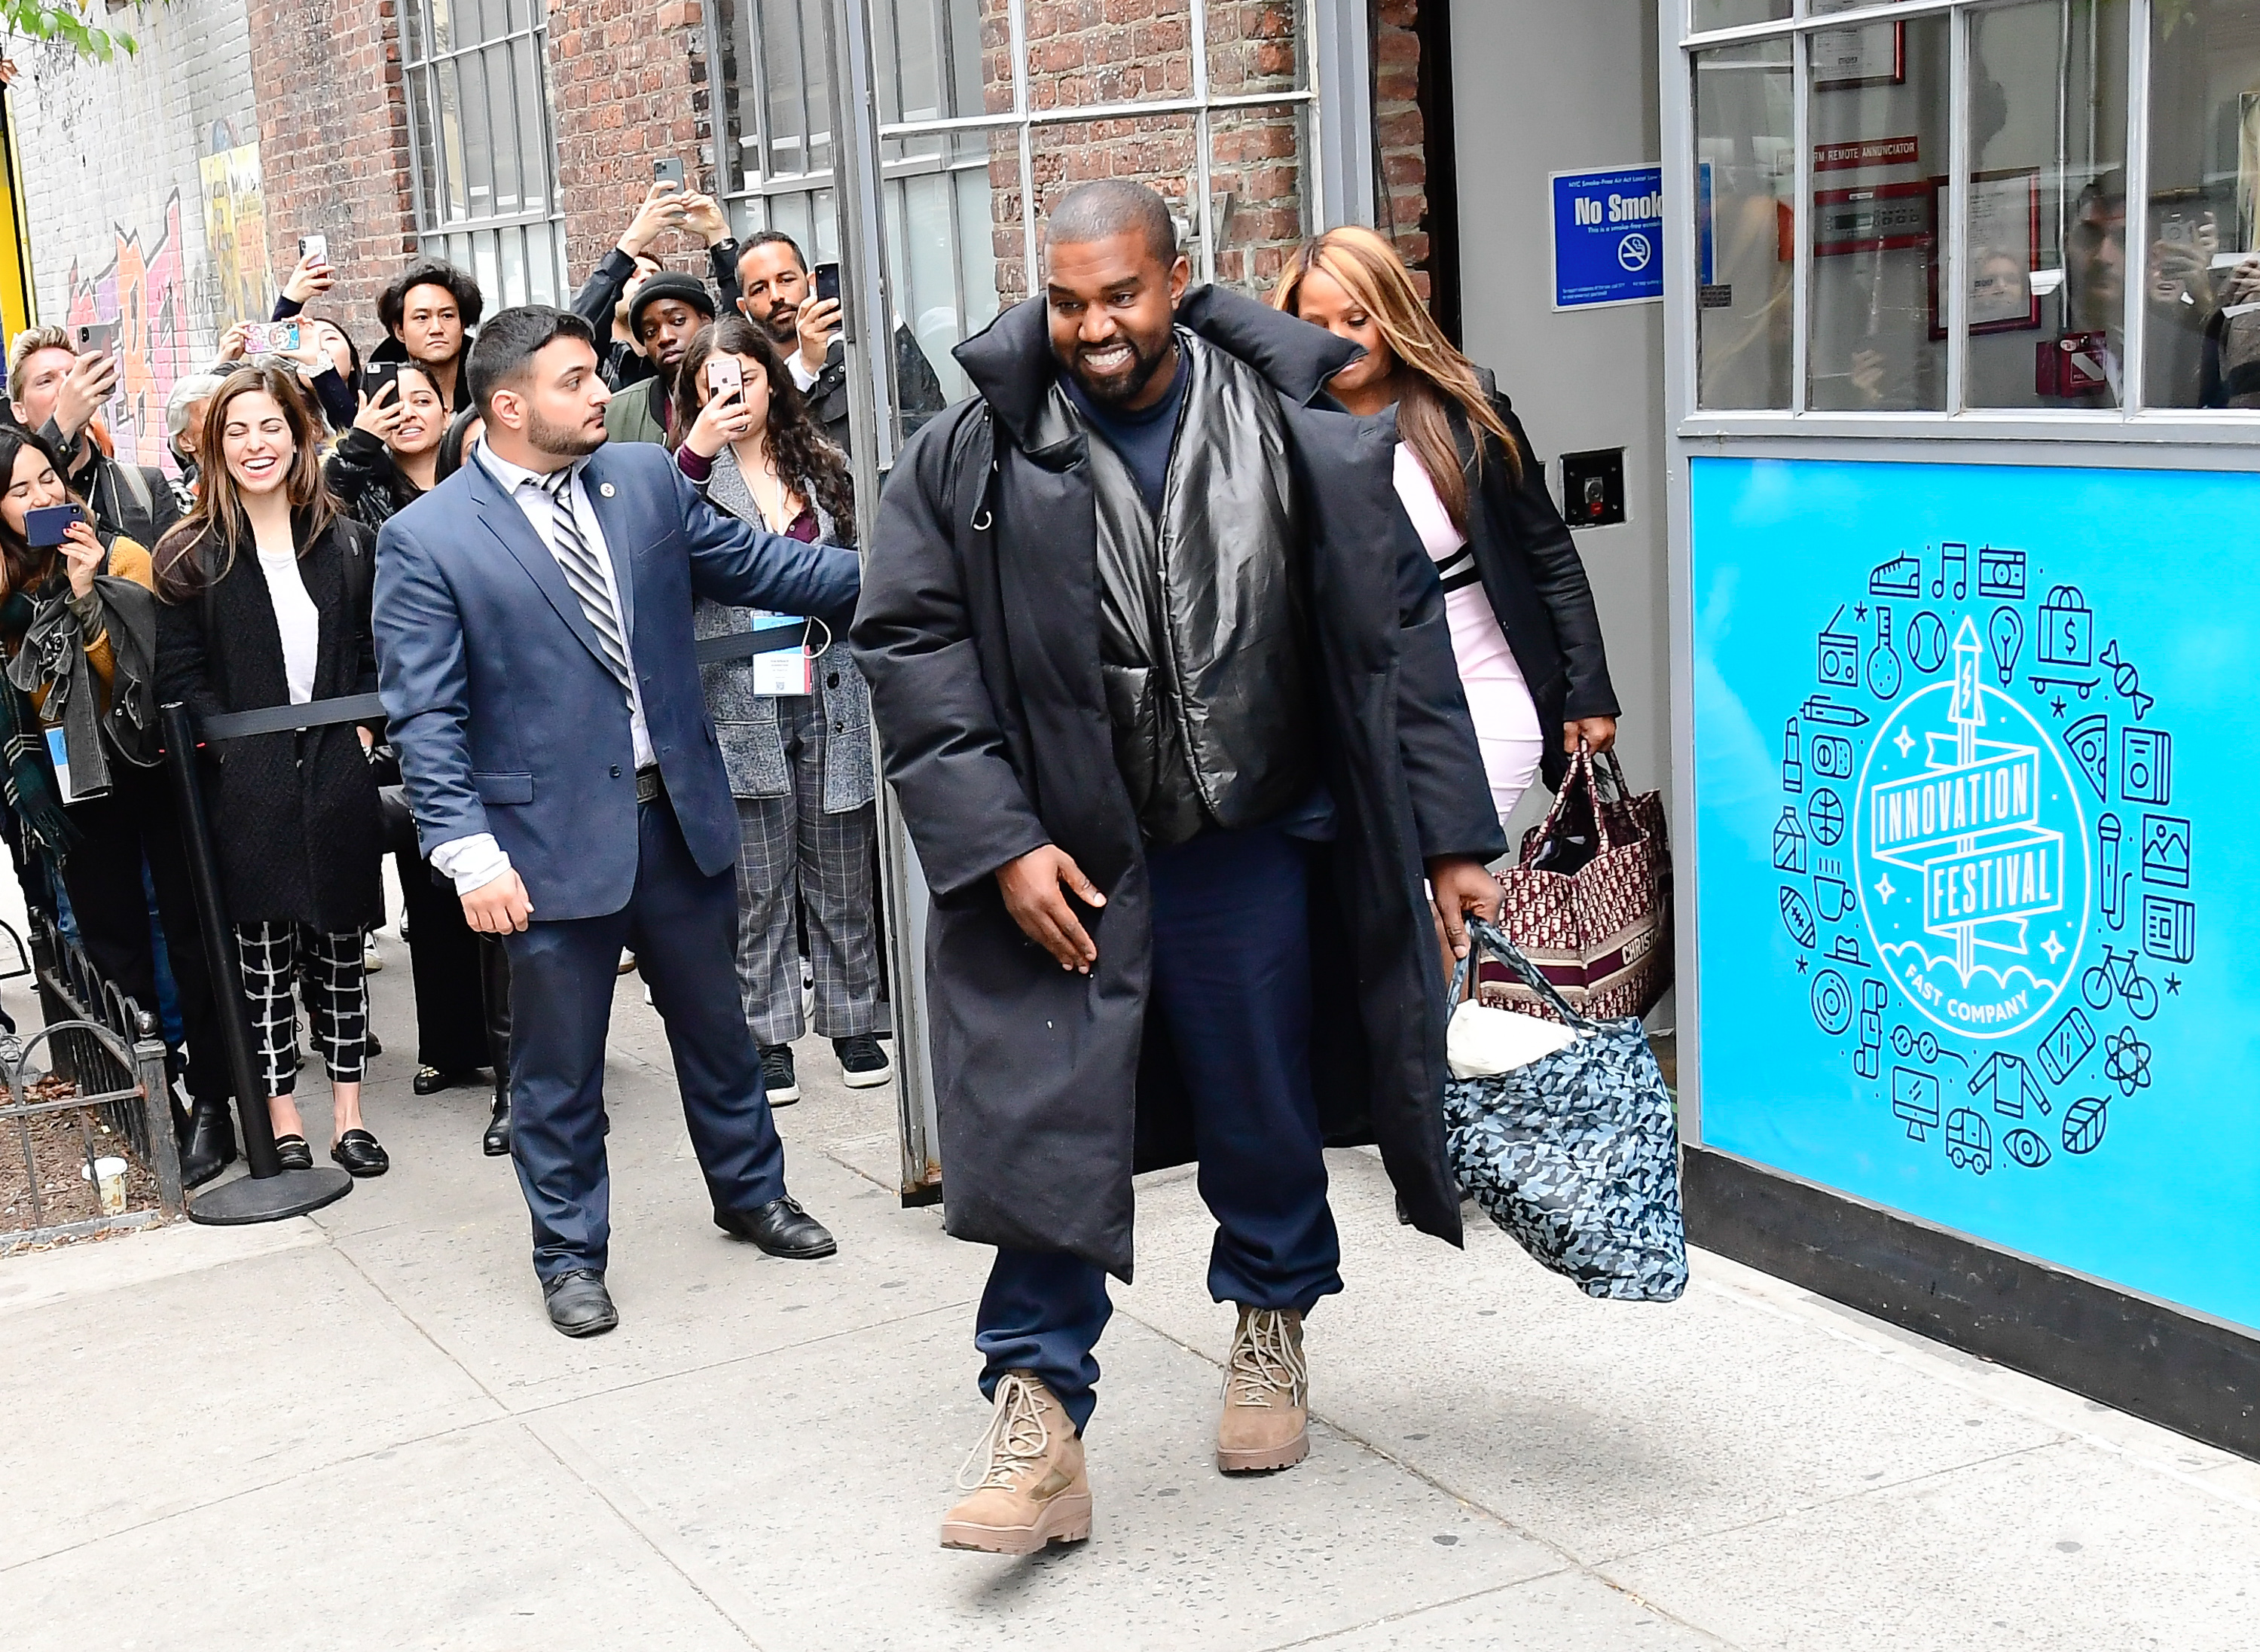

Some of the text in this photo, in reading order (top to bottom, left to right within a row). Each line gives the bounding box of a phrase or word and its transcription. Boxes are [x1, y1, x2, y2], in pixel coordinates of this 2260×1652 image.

[1828, 148, 1858, 161] REMOTE
[1861, 142, 1915, 157] ANNUNCIATOR
[1574, 190, 1663, 226] No Smok
[1880, 762, 2028, 844] INNOVATION
[1933, 848, 2051, 919] FESTIVAL
[1622, 928, 1655, 965] CHRIST
[1905, 963, 2029, 1024] FAST COMPANY
